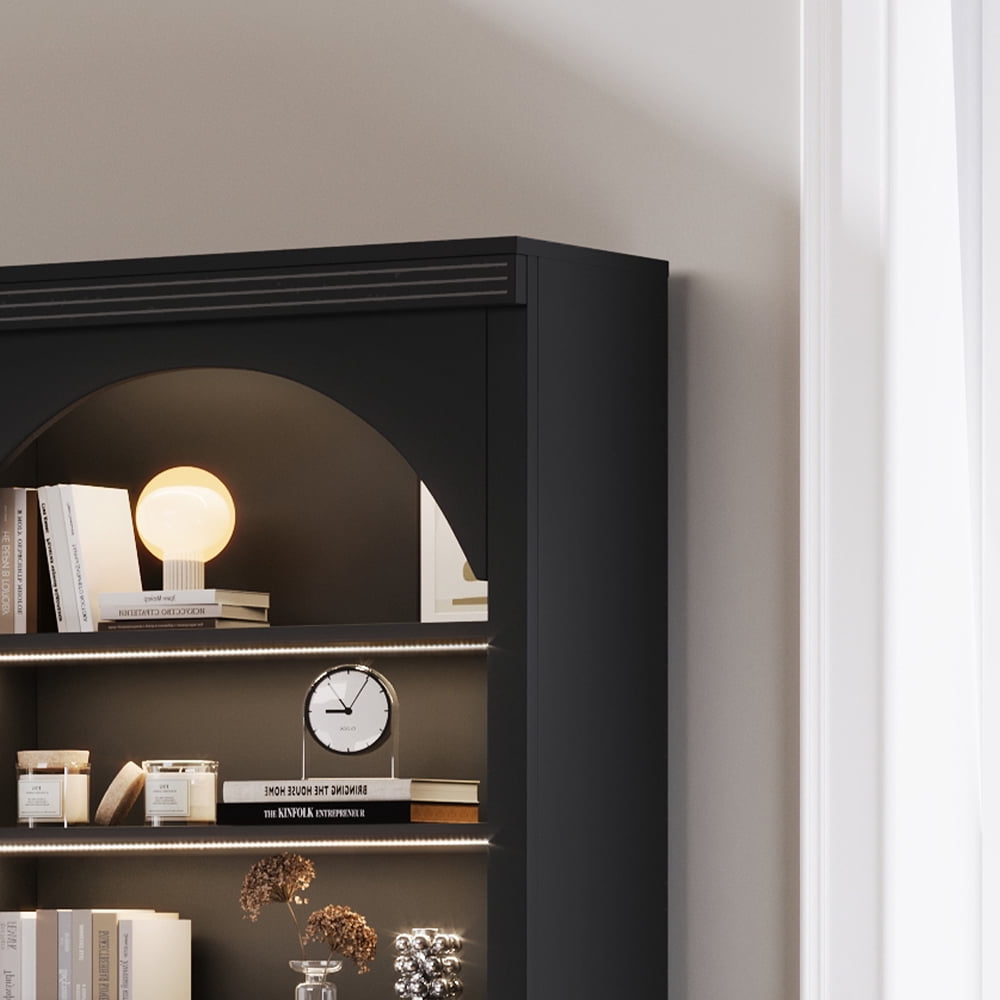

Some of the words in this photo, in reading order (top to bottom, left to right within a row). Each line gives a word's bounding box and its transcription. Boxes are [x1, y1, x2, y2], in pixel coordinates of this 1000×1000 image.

[264, 809, 277, 819] THE
[278, 807, 314, 819] KINFOLK
[316, 808, 365, 818] ENTREPRENEUR
